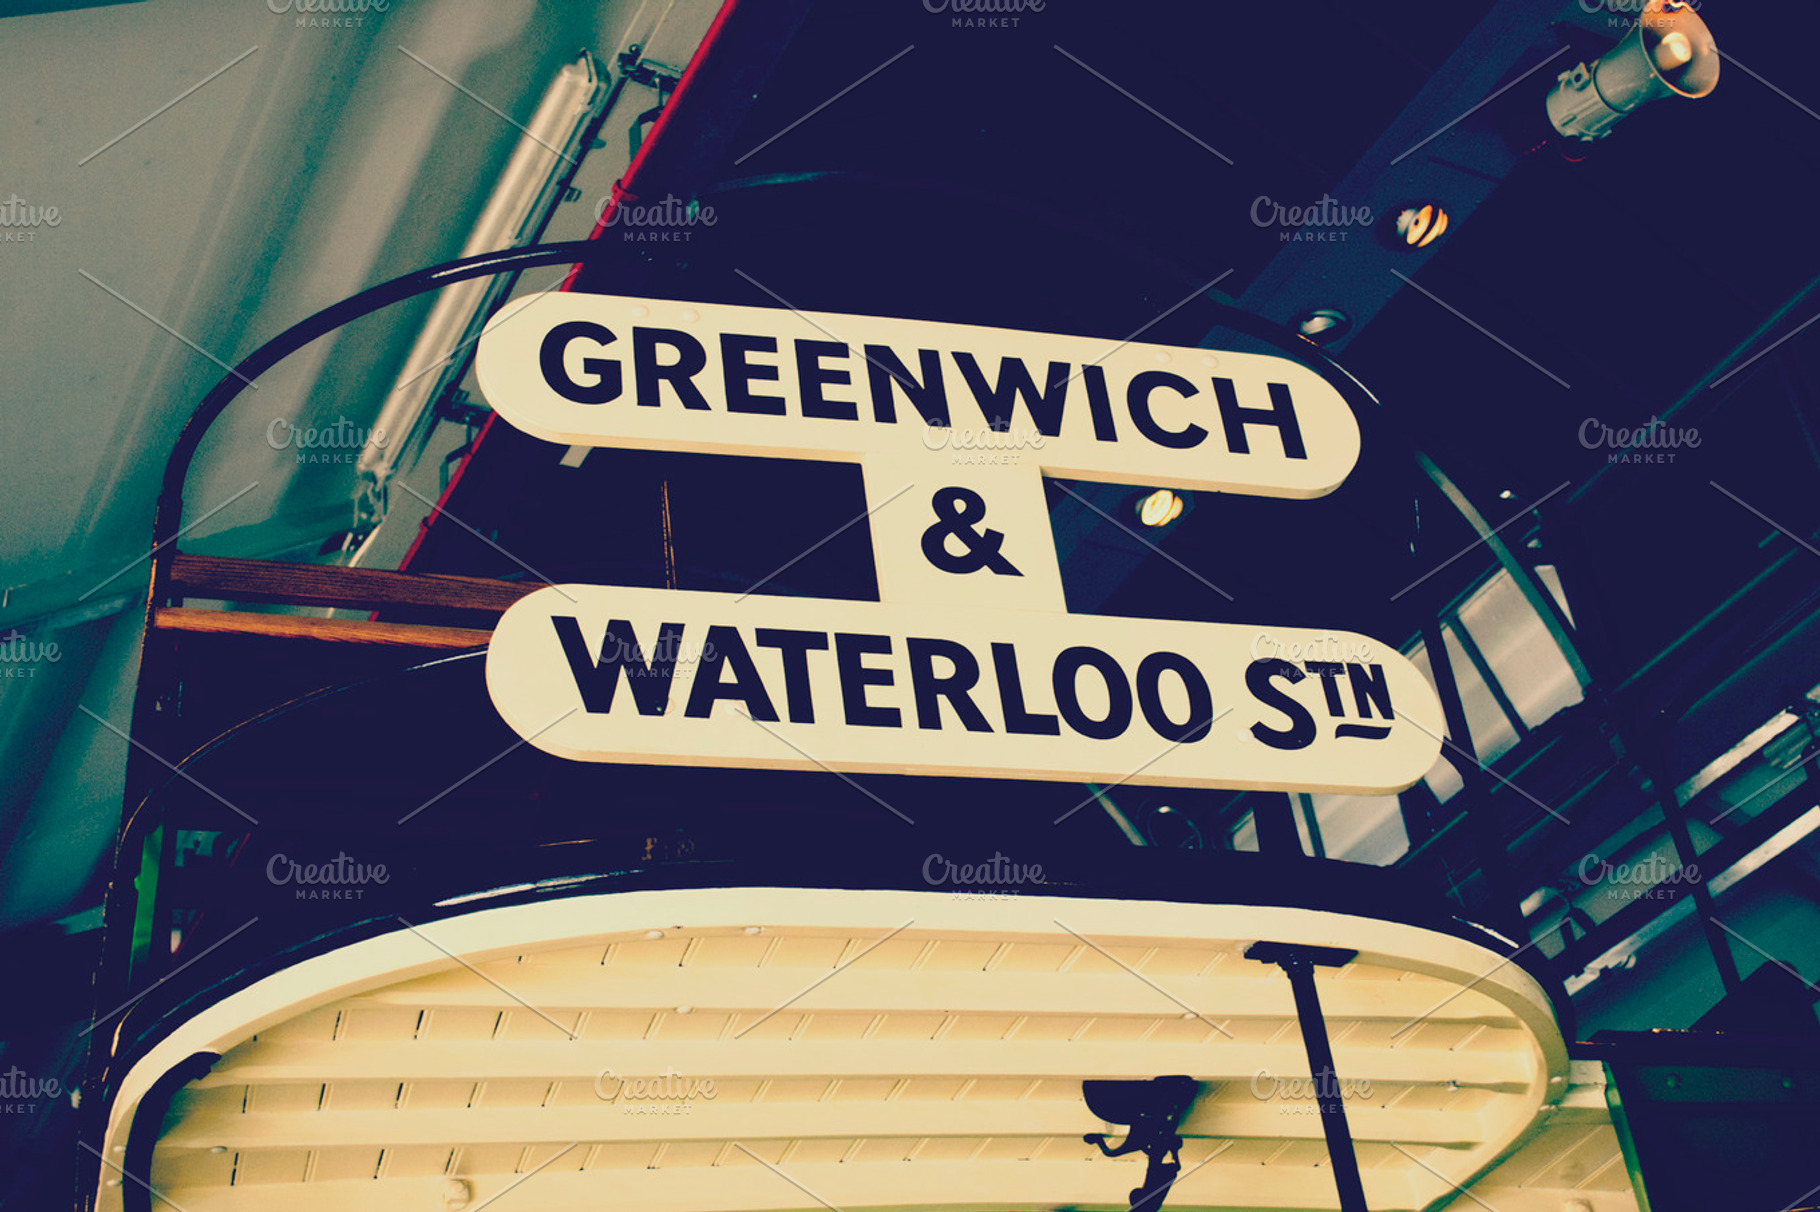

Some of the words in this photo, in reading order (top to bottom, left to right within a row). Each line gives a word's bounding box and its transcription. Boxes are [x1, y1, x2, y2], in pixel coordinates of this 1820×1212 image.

[540, 322, 1307, 459] GREENWICH
[921, 487, 1024, 576] &
[551, 616, 1213, 743] WATERLOO
